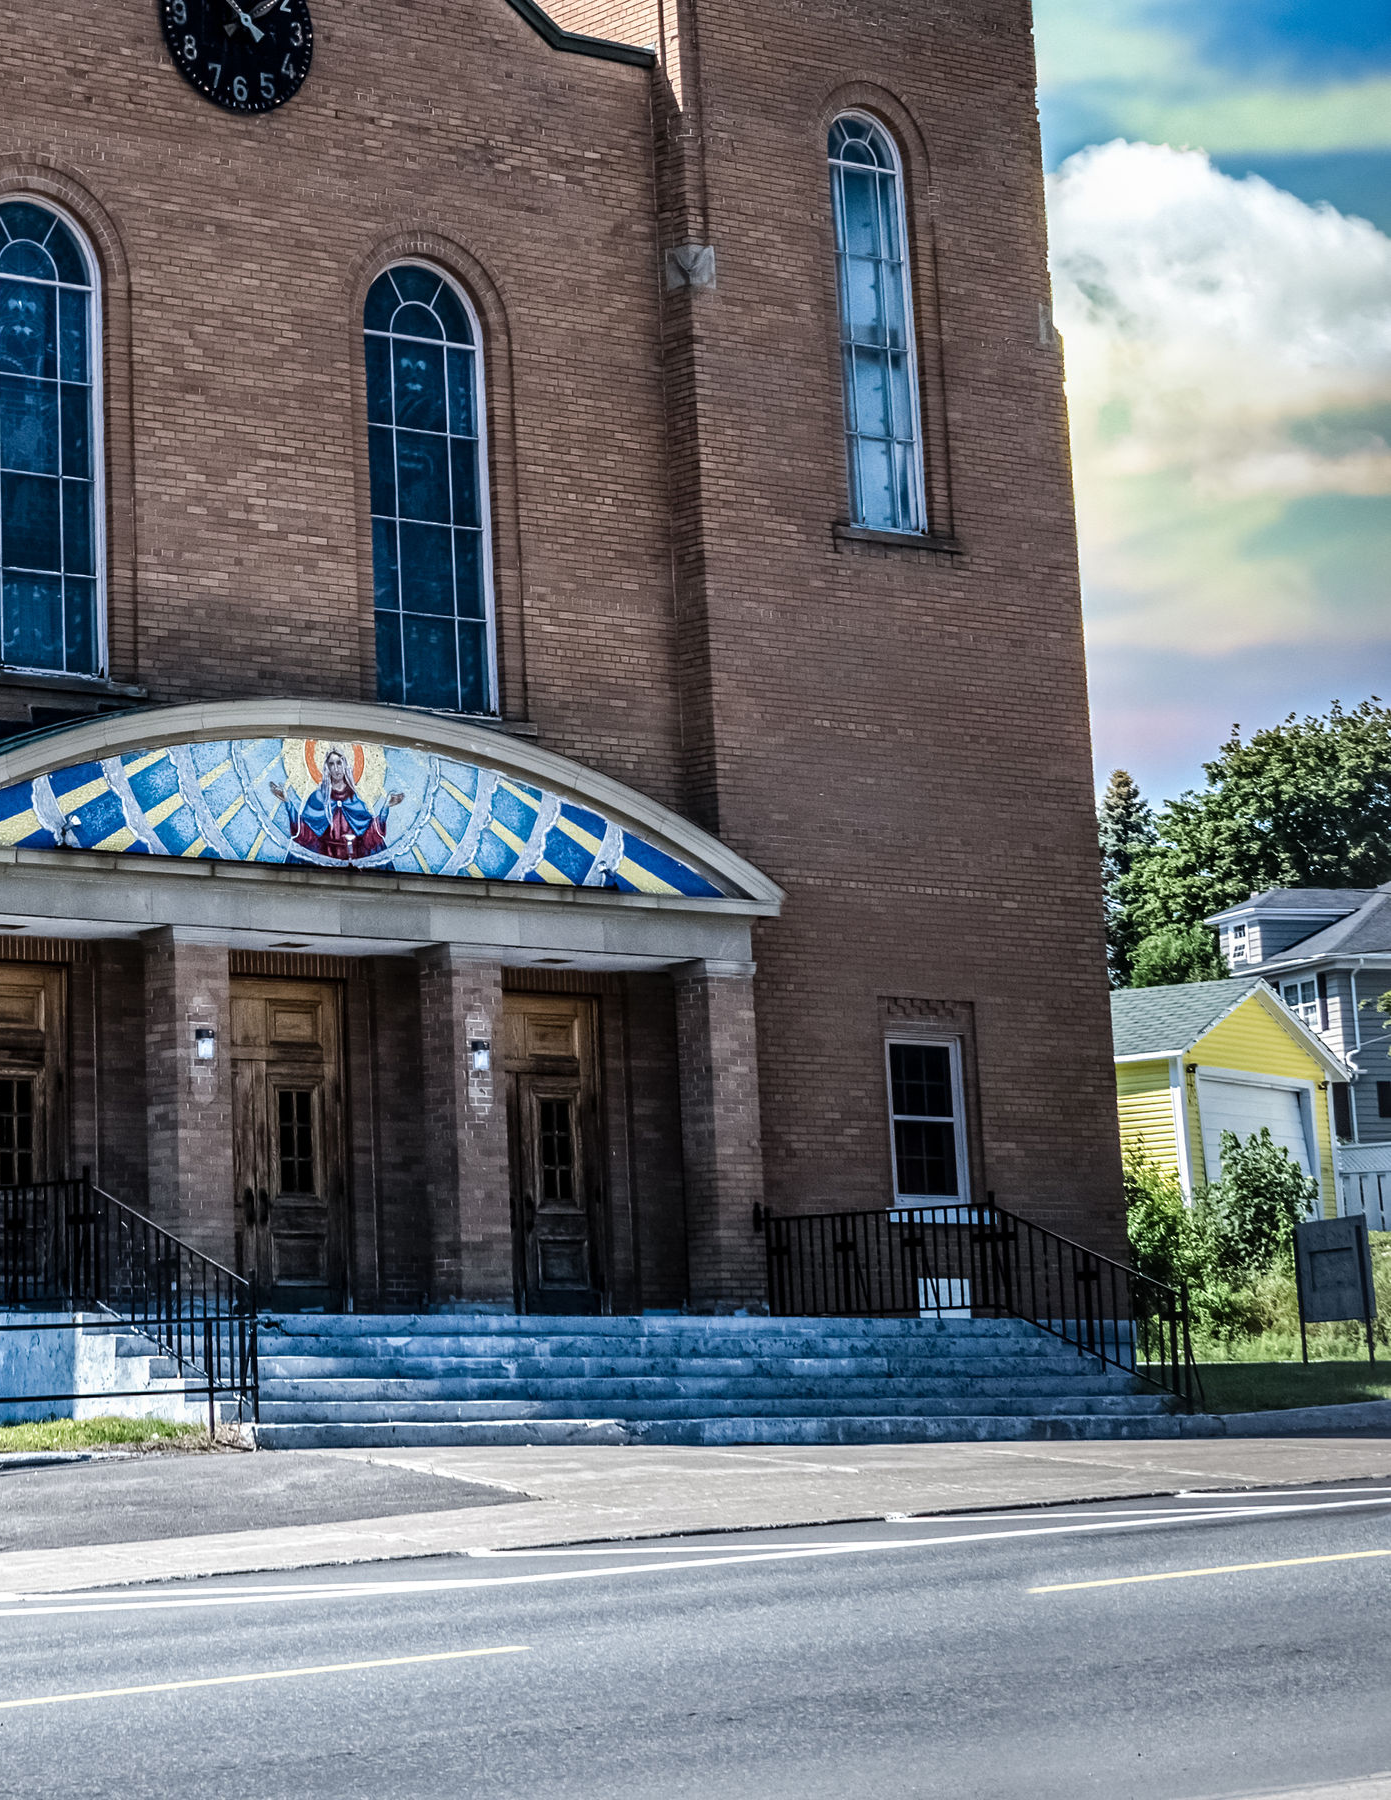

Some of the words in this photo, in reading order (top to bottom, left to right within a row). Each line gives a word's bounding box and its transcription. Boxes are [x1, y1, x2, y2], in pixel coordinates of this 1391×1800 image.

[184, 34, 198, 61] 8
[290, 21, 303, 47] 3
[209, 62, 222, 89] 7
[281, 52, 296, 80] 4
[233, 75, 248, 102] 6
[260, 72, 276, 99] 5
